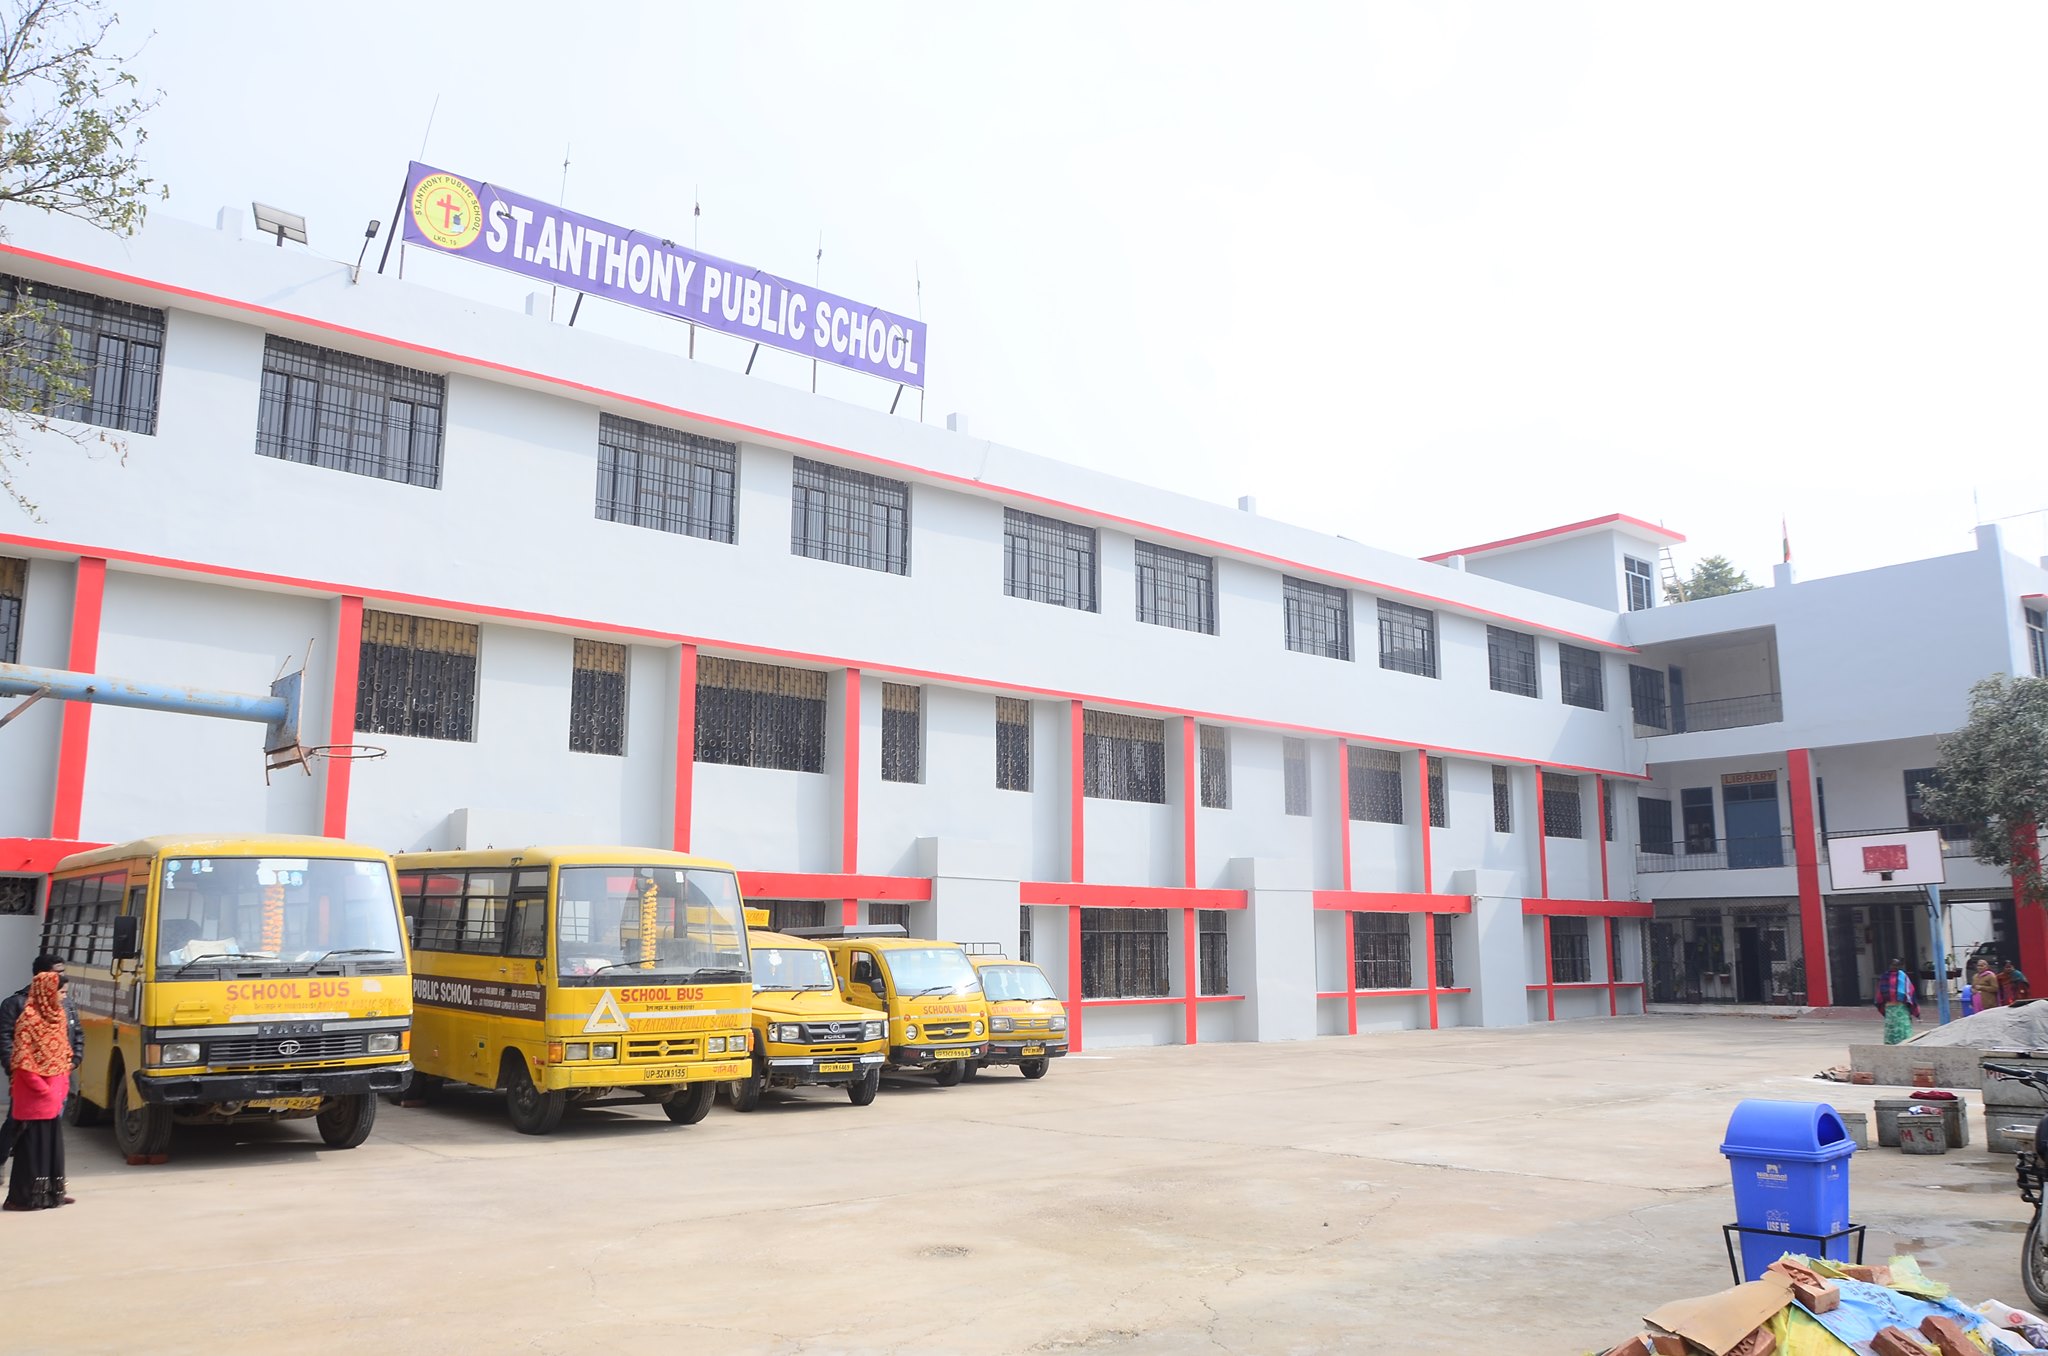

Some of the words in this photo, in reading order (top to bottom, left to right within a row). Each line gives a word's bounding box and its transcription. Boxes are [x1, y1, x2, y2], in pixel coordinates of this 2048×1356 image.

[445, 176, 474, 198] PUBLIC
[470, 199, 482, 232] SCHOOL
[701, 265, 808, 341] PUBLIC
[813, 301, 919, 375] SCHOOL
[1725, 772, 1774, 784] LIBRARY
[226, 983, 301, 1002] SCHOOL
[309, 981, 350, 999] BUS
[413, 979, 439, 1001] PUBLIC
[440, 982, 473, 1006] SCHOOL
[620, 988, 671, 1003] SCHOOL
[677, 988, 704, 1001] BUS
[923, 1006, 952, 1015] SCHOOL
[953, 1004, 968, 1013] VAN
[263, 1023, 319, 1036] TATA
[1766, 1221, 1779, 1232] USE
[1780, 1222, 1790, 1233] ME
